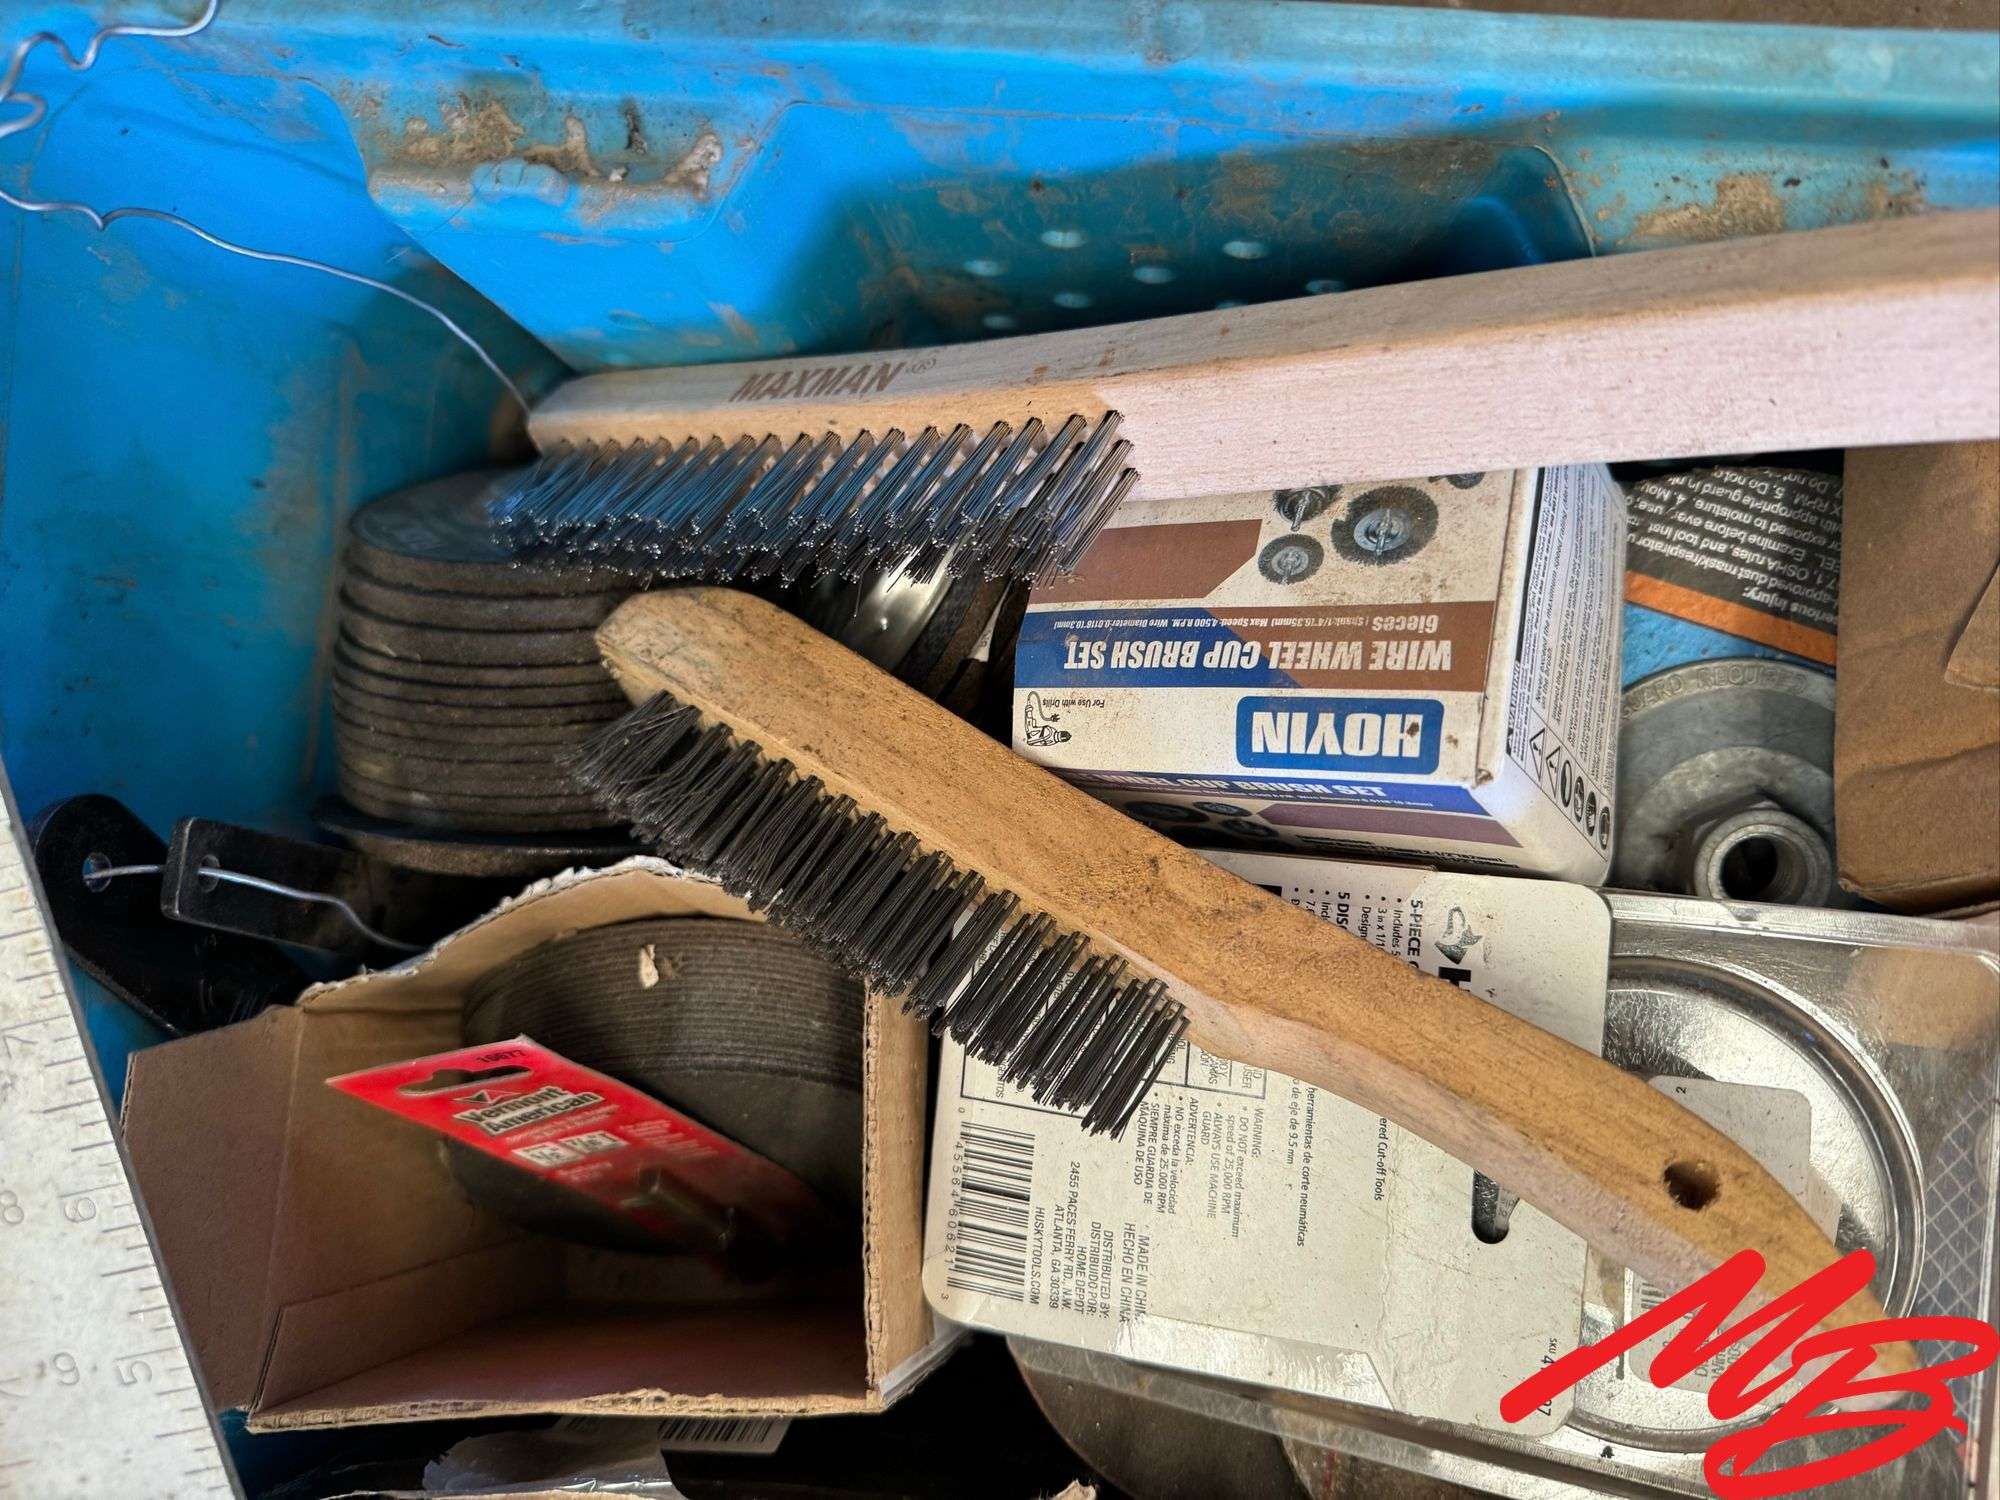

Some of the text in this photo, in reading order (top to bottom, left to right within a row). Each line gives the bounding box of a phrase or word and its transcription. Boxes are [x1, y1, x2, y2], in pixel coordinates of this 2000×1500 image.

[728, 363, 906, 402] MAXMAN
[1640, 483, 1670, 500] Mou
[1748, 478, 1769, 494] Do
[1692, 498, 1751, 524] moisture.
[1754, 518, 1768, 531] to
[1648, 523, 1673, 540] inst
[1675, 528, 1699, 548] tool
[1701, 538, 1726, 554] and
[1704, 521, 1747, 544] before
[1747, 534, 1806, 560] Examine
[1738, 566, 1768, 584] dust
[1767, 557, 1810, 581] OSHA
[1149, 619, 1168, 628] Wire
[1220, 617, 1249, 627] Speed:
[1250, 618, 1268, 627] Max
[1063, 639, 1452, 671] WIRE WHEEL CUP BRUSH SET
[1042, 698, 1105, 708] For Use with Drills
[1251, 711, 1424, 758] HOYIN
[1235, 780, 1333, 794] BRUSH
[1332, 785, 1387, 797] SET
[1360, 907, 1371, 938] Design
[1391, 910, 1403, 947] Includes
[1407, 899, 1424, 956] 5-PIECE
[458, 1086, 567, 1121] Vermont
[486, 1093, 600, 1132] American
[1185, 1097, 1198, 1166] ADVERTENCIA:
[1200, 1111, 1211, 1145] GUARD
[1251, 1108, 1263, 1158] WARNING:
[1287, 1088, 1301, 1164] de eje de 9.5 mm
[1135, 1150, 1145, 1162] DE
[1143, 1103, 1160, 1204] SIEMPRE GUARDIA DE
[1157, 1104, 1173, 1214] máxima de 25.000 RPM
[1167, 1106, 1184, 1214] NO exceda la velocidad
[1206, 1113, 1222, 1218] ALWAYS USE MACHINE
[1221, 1114, 1236, 1214] speed of 25,000 RPM
[1297, 1087, 1316, 1246] herramientas de corte neumáticas
[1374, 1118, 1388, 1201] ered Cut-off Tools
[1069, 1161, 1080, 1187] 2455
[1134, 1165, 1144, 1185] USO
[1232, 1117, 1249, 1238] DO NOT exceed maximum
[1066, 1190, 1079, 1226] PACES
[1029, 1206, 1045, 1305] HUSKYTOOLS.COM
[1048, 1204, 1065, 1309] ATLANTA, GA 30339
[1064, 1228, 1077, 1262] FERRY
[1136, 1235, 1150, 1271] MADE
[1074, 1246, 1087, 1314] HOME DEPOT
[1086, 1221, 1101, 1316] DISTRIBUIDO POR:
[1098, 1230, 1113, 1319] DISTRIBUTED BY:
[1119, 1223, 1135, 1323] HECHO EN CHINA
[1136, 1273, 1148, 1285] IN
[1548, 1338, 1557, 1353] SKU
